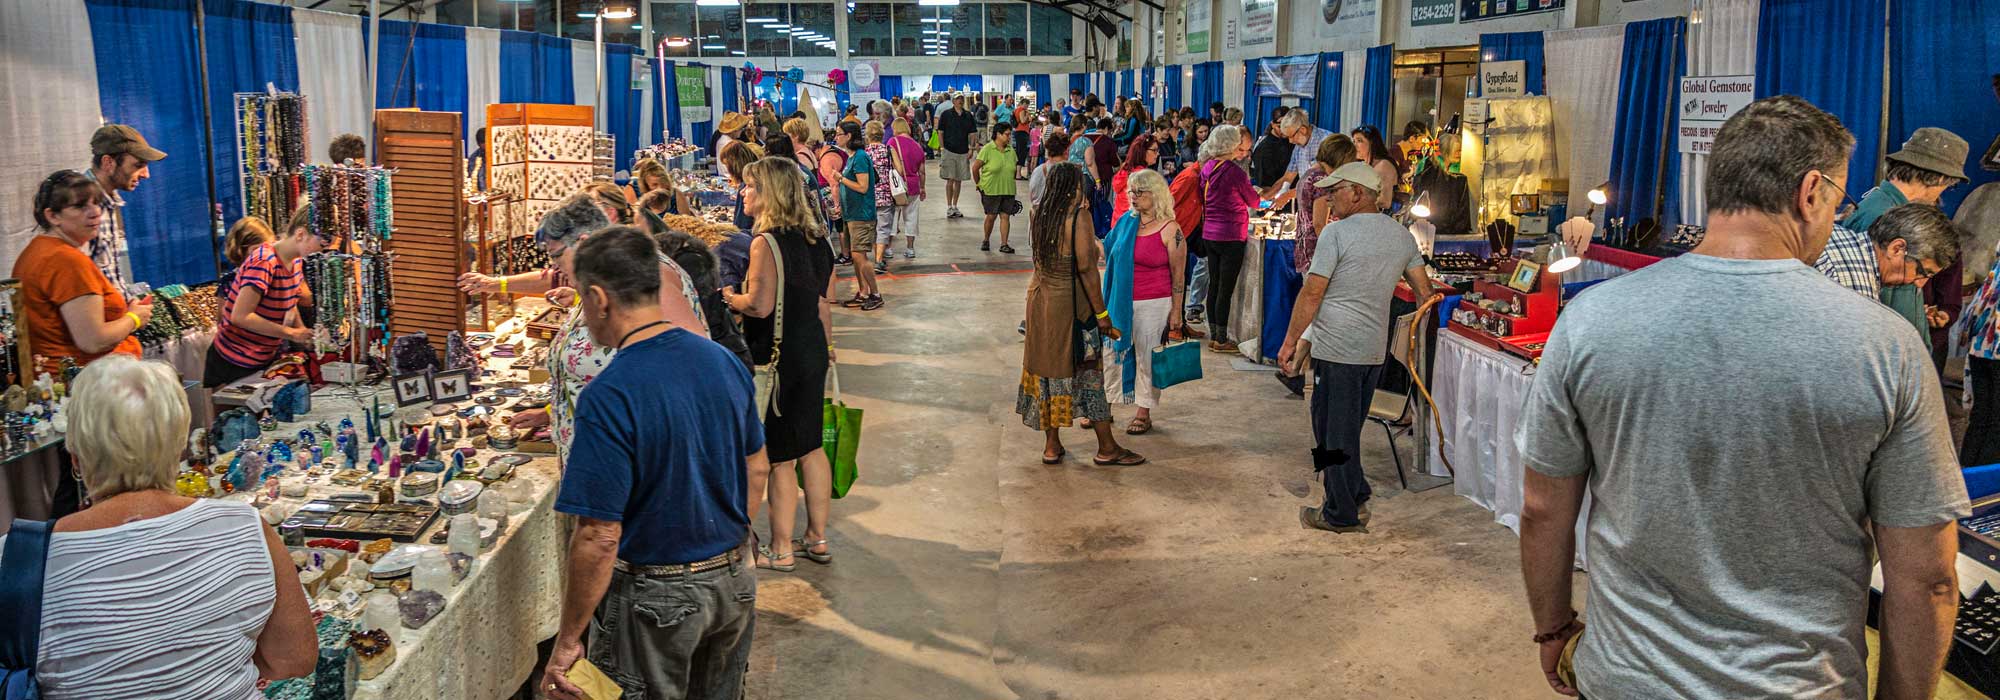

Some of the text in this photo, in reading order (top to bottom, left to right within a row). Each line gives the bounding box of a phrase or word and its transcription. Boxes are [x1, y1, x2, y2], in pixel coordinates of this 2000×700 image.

[1418, 4, 1454, 20] 254-2292
[1682, 80, 1752, 93] Global Gemstone
[1701, 100, 1728, 117] Jewelry
